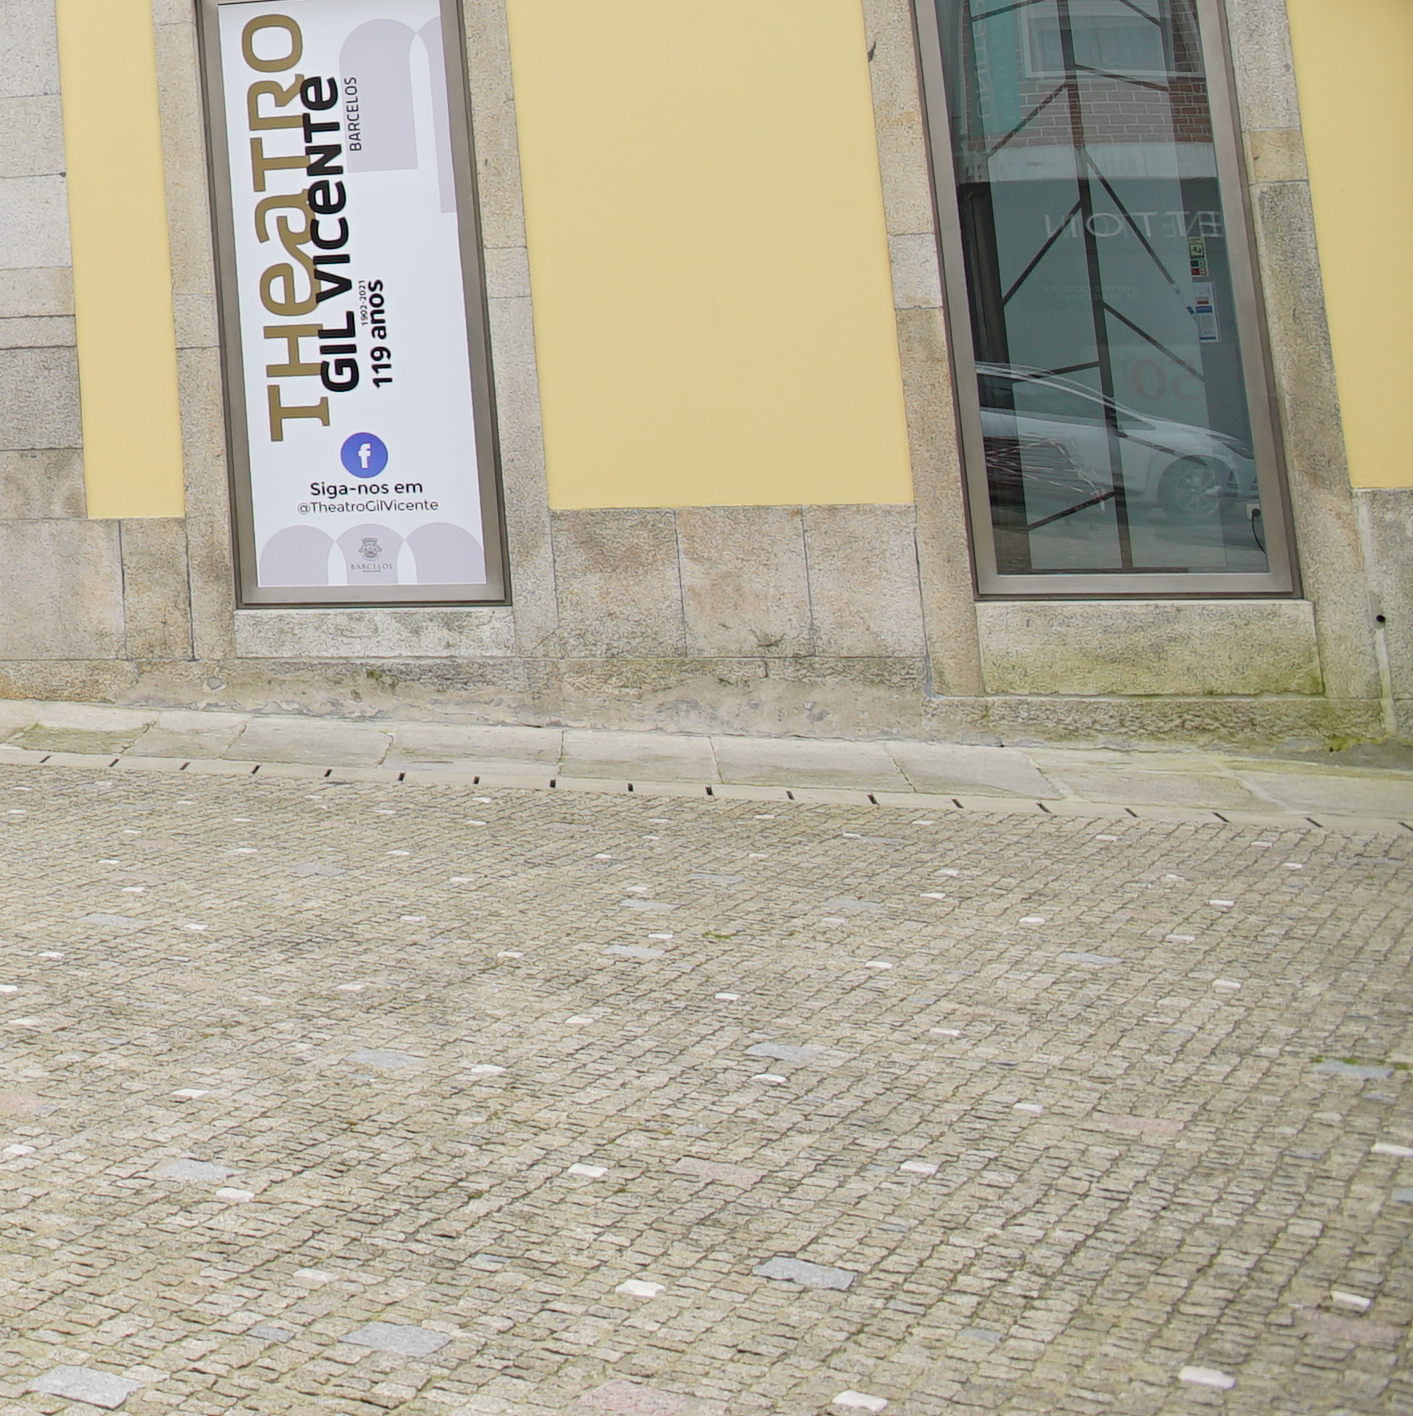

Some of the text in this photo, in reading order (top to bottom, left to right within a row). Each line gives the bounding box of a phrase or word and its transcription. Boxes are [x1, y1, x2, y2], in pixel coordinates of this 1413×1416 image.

[344, 77, 362, 151] BARCELOS
[318, 311, 360, 392] GIL
[368, 279, 393, 389] 119 anos
[297, 499, 439, 515] @TheatroGilVicente
[310, 481, 423, 499] Siga-nos em
